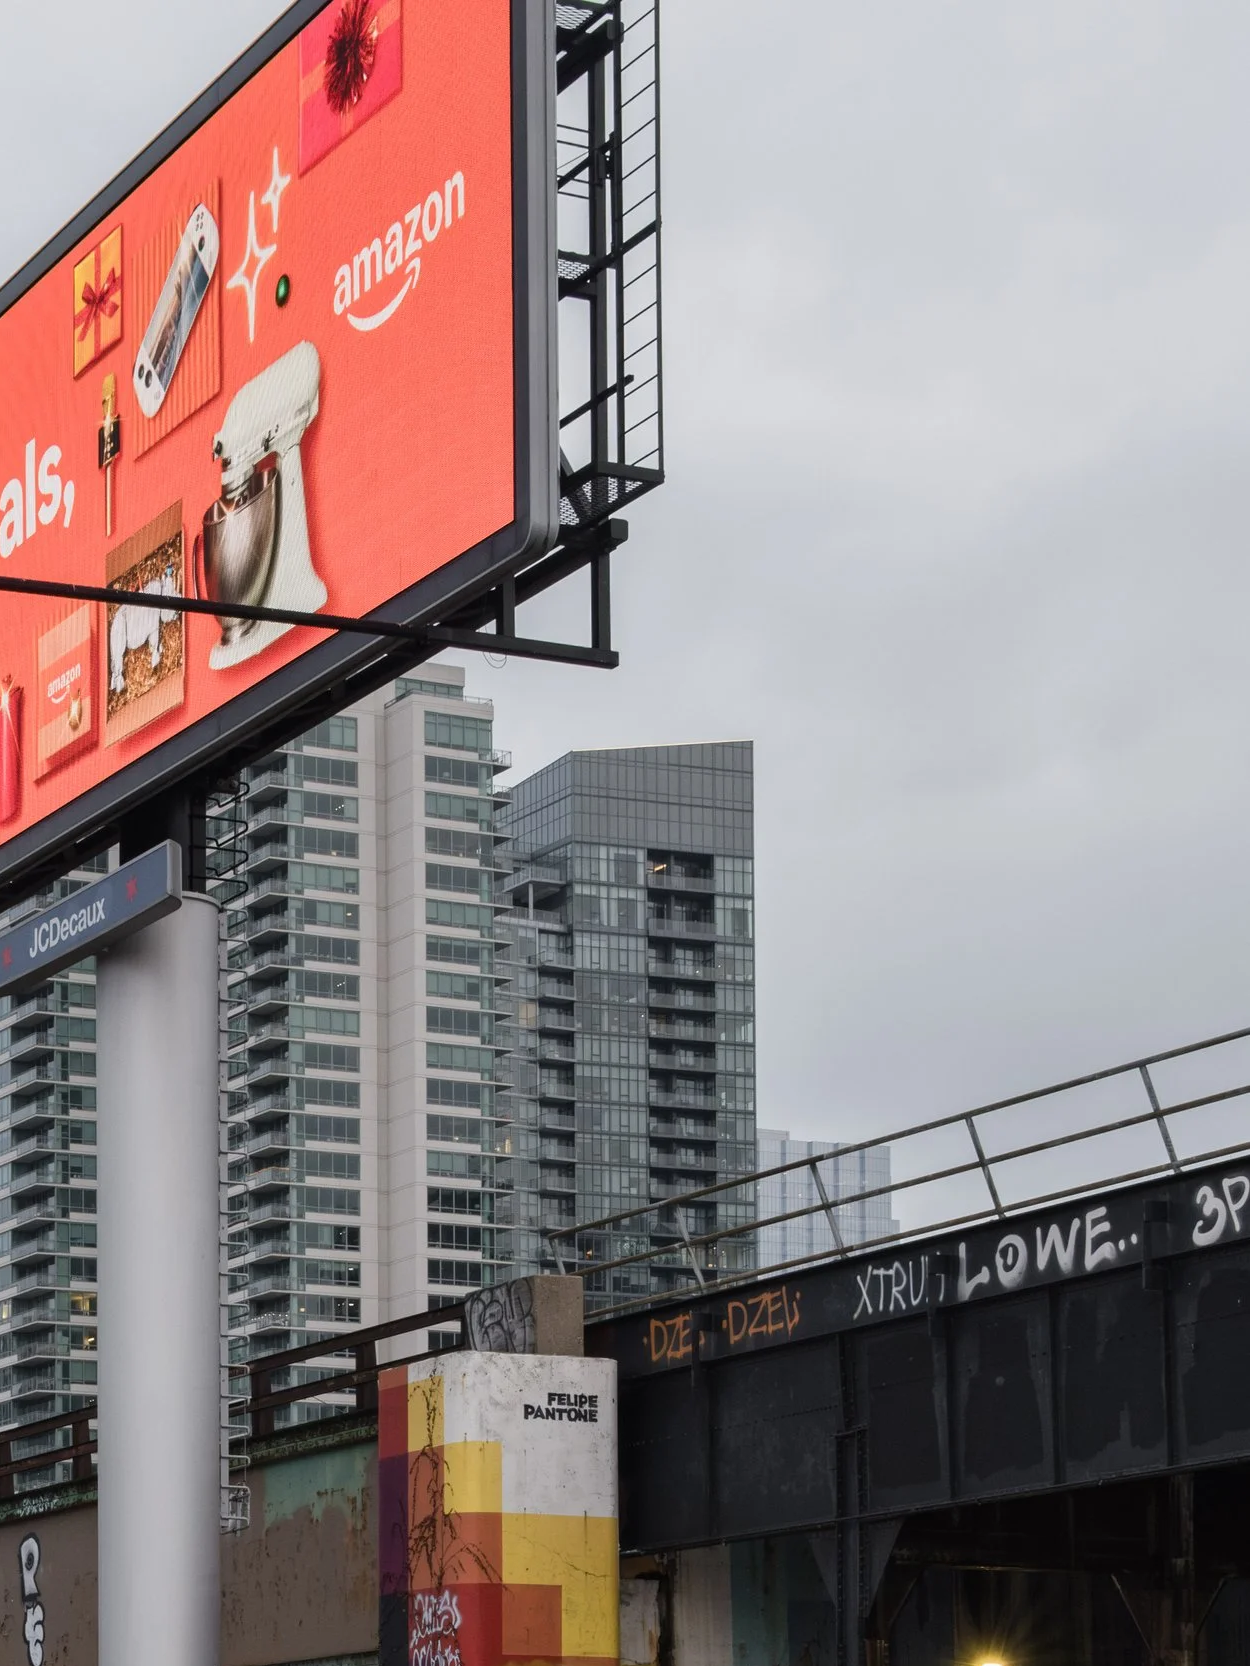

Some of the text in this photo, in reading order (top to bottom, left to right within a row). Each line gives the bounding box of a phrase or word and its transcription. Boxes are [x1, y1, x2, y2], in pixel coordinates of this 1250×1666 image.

[333, 170, 466, 316] amazon
[47, 663, 81, 698] amazon
[29, 898, 106, 959] JCDecaux
[524, 1404, 598, 1422] PANTONE
[547, 1392, 598, 1408] FELIPE
